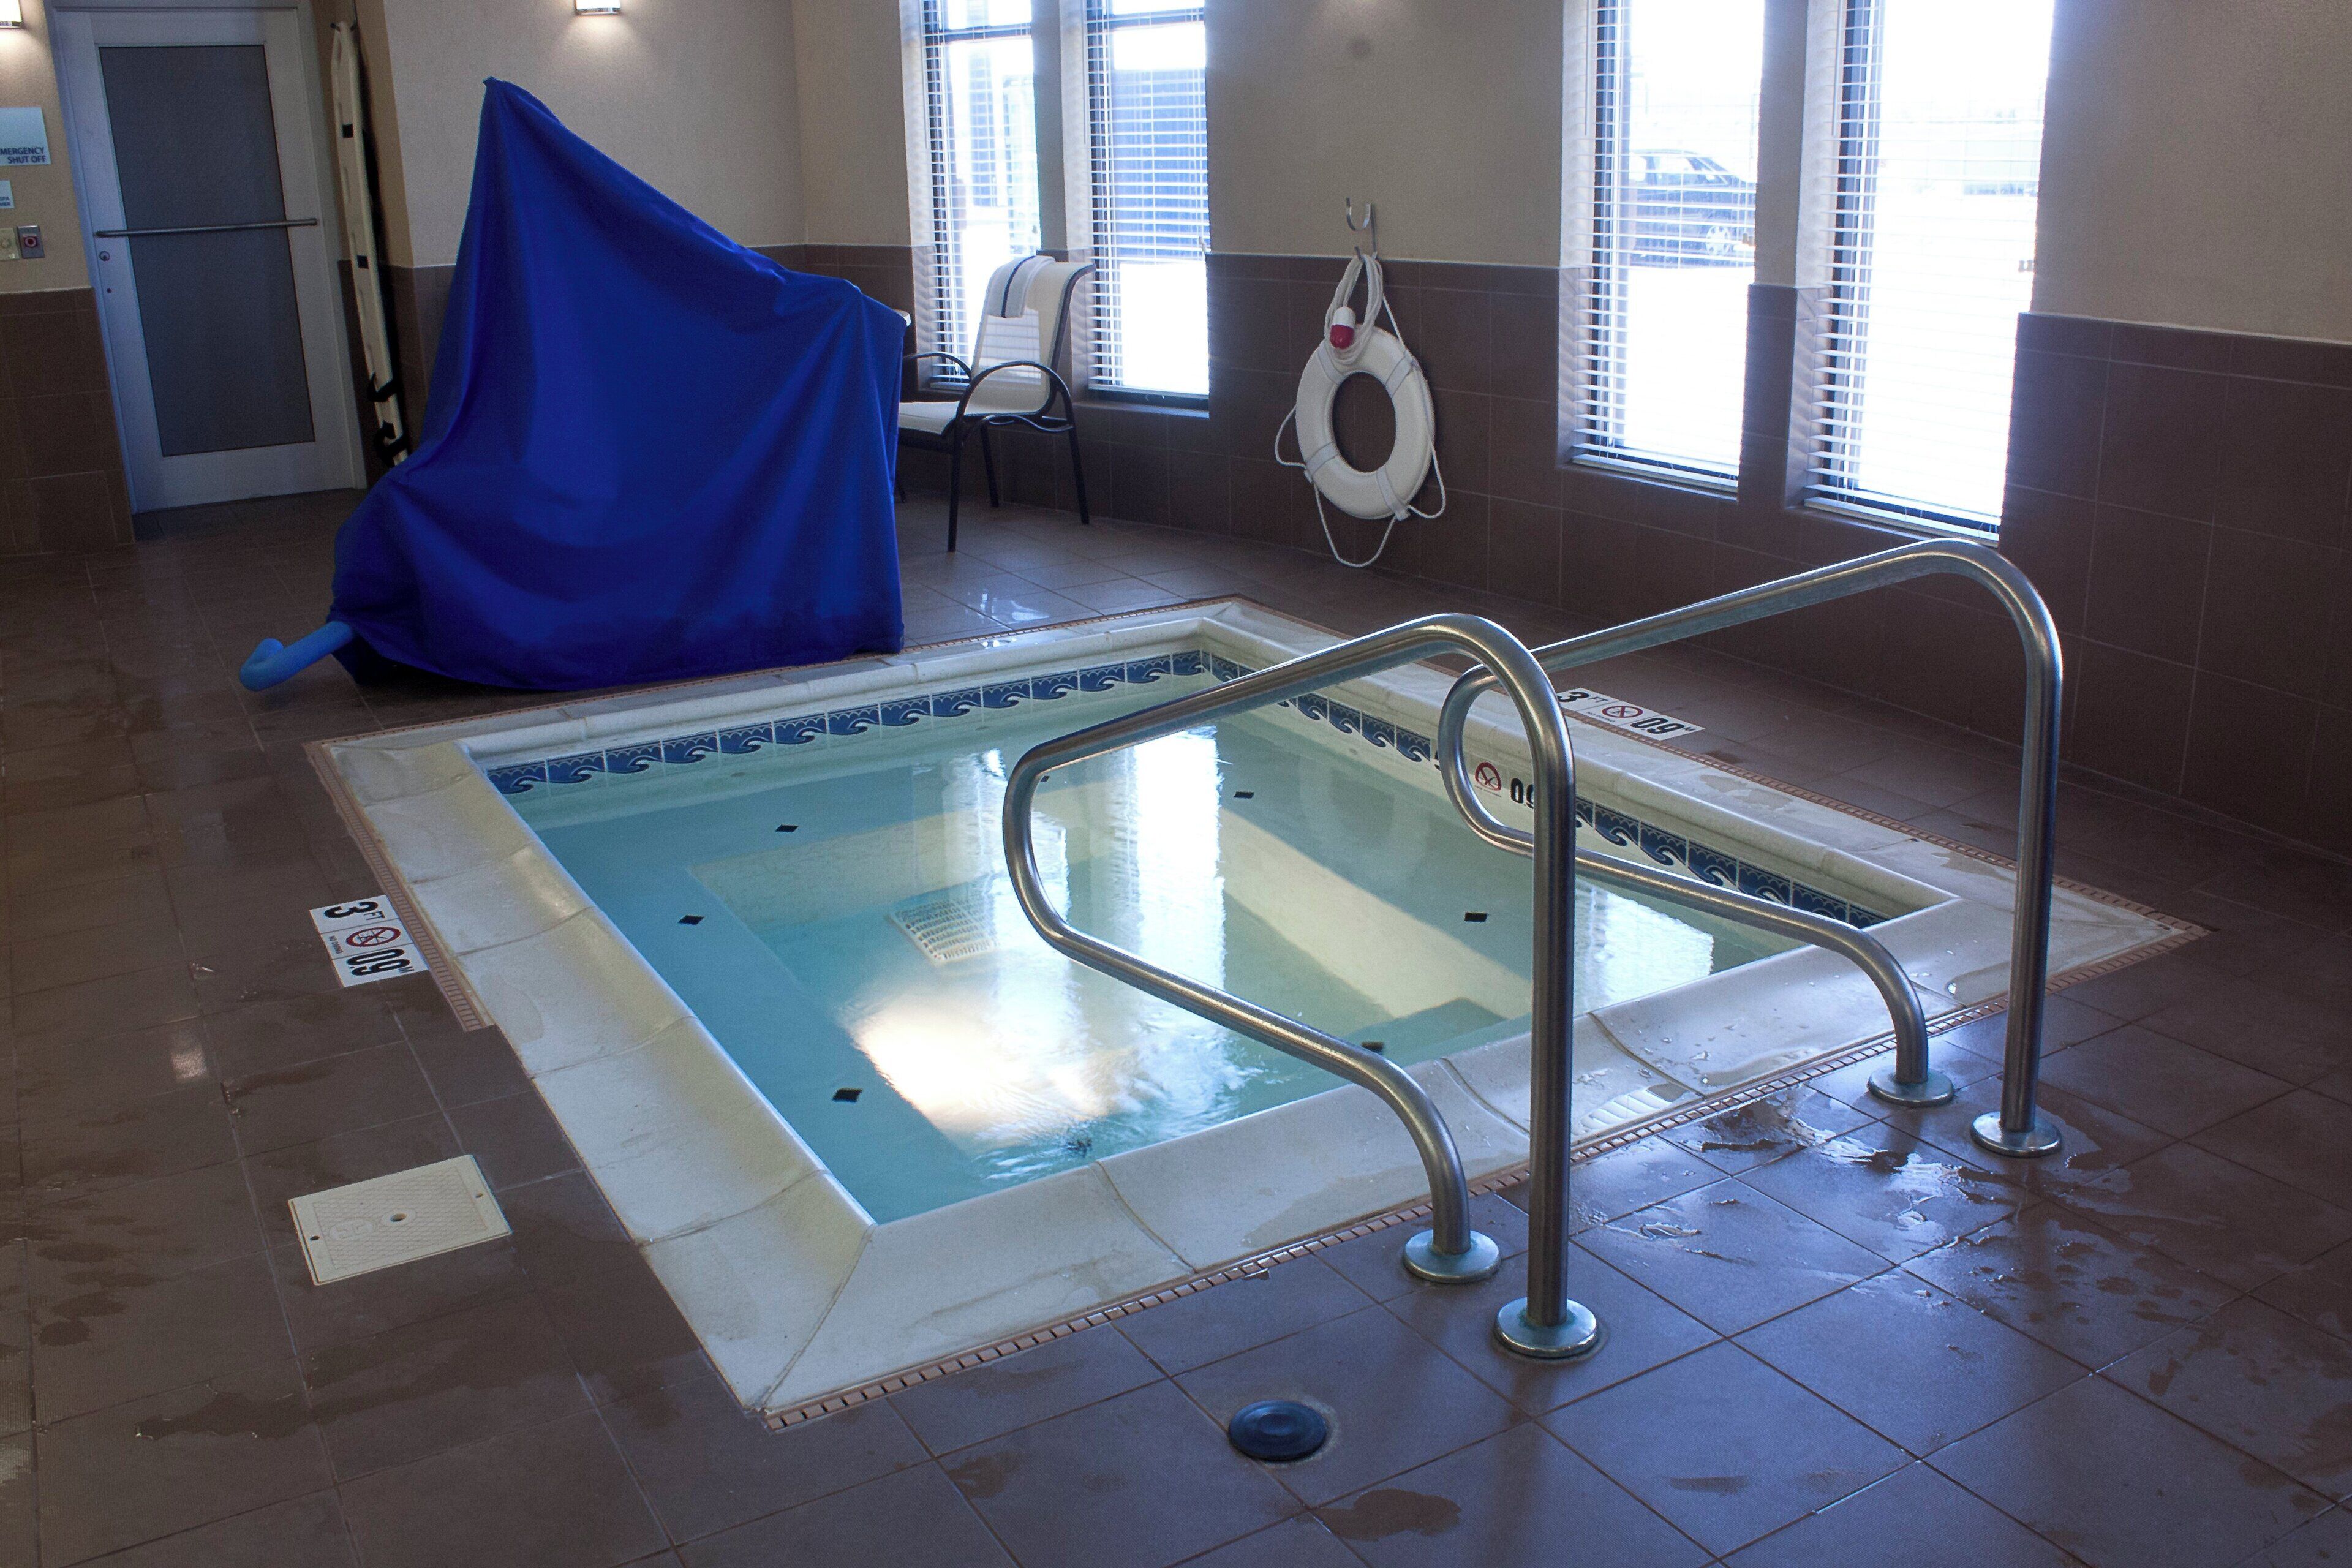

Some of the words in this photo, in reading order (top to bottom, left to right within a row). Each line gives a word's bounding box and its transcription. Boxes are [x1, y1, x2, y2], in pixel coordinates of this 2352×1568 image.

[1557, 692, 1590, 703] 3
[1630, 717, 1684, 734] 0.9
[324, 901, 379, 918] 3
[364, 911, 386, 921] FT
[346, 949, 410, 976] 0.9
